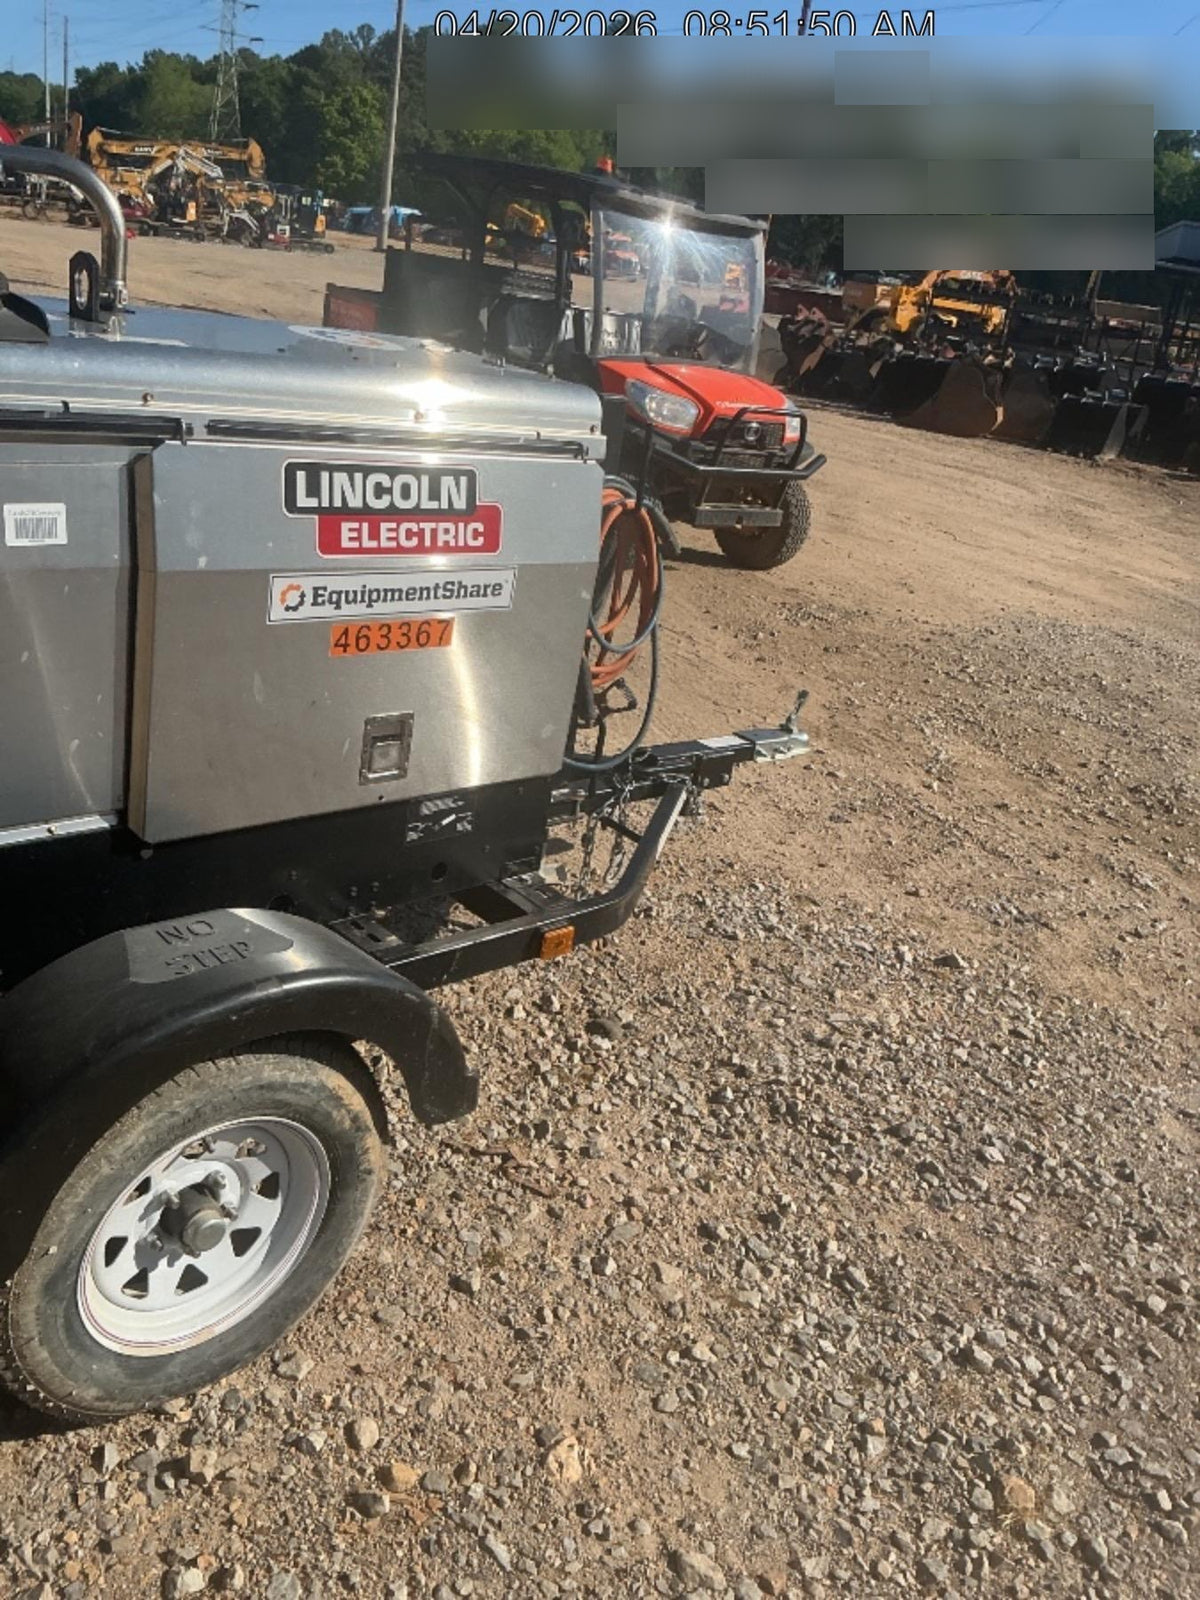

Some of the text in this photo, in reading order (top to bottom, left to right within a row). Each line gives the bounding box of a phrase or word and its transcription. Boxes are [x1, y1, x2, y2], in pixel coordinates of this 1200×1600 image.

[296, 470, 467, 510] LINCOLN
[340, 521, 485, 549] ELECTRIC
[310, 580, 504, 610] EquipmentShare
[333, 619, 452, 653] 463367
[156, 920, 215, 945] NO
[164, 941, 252, 975] STEP
